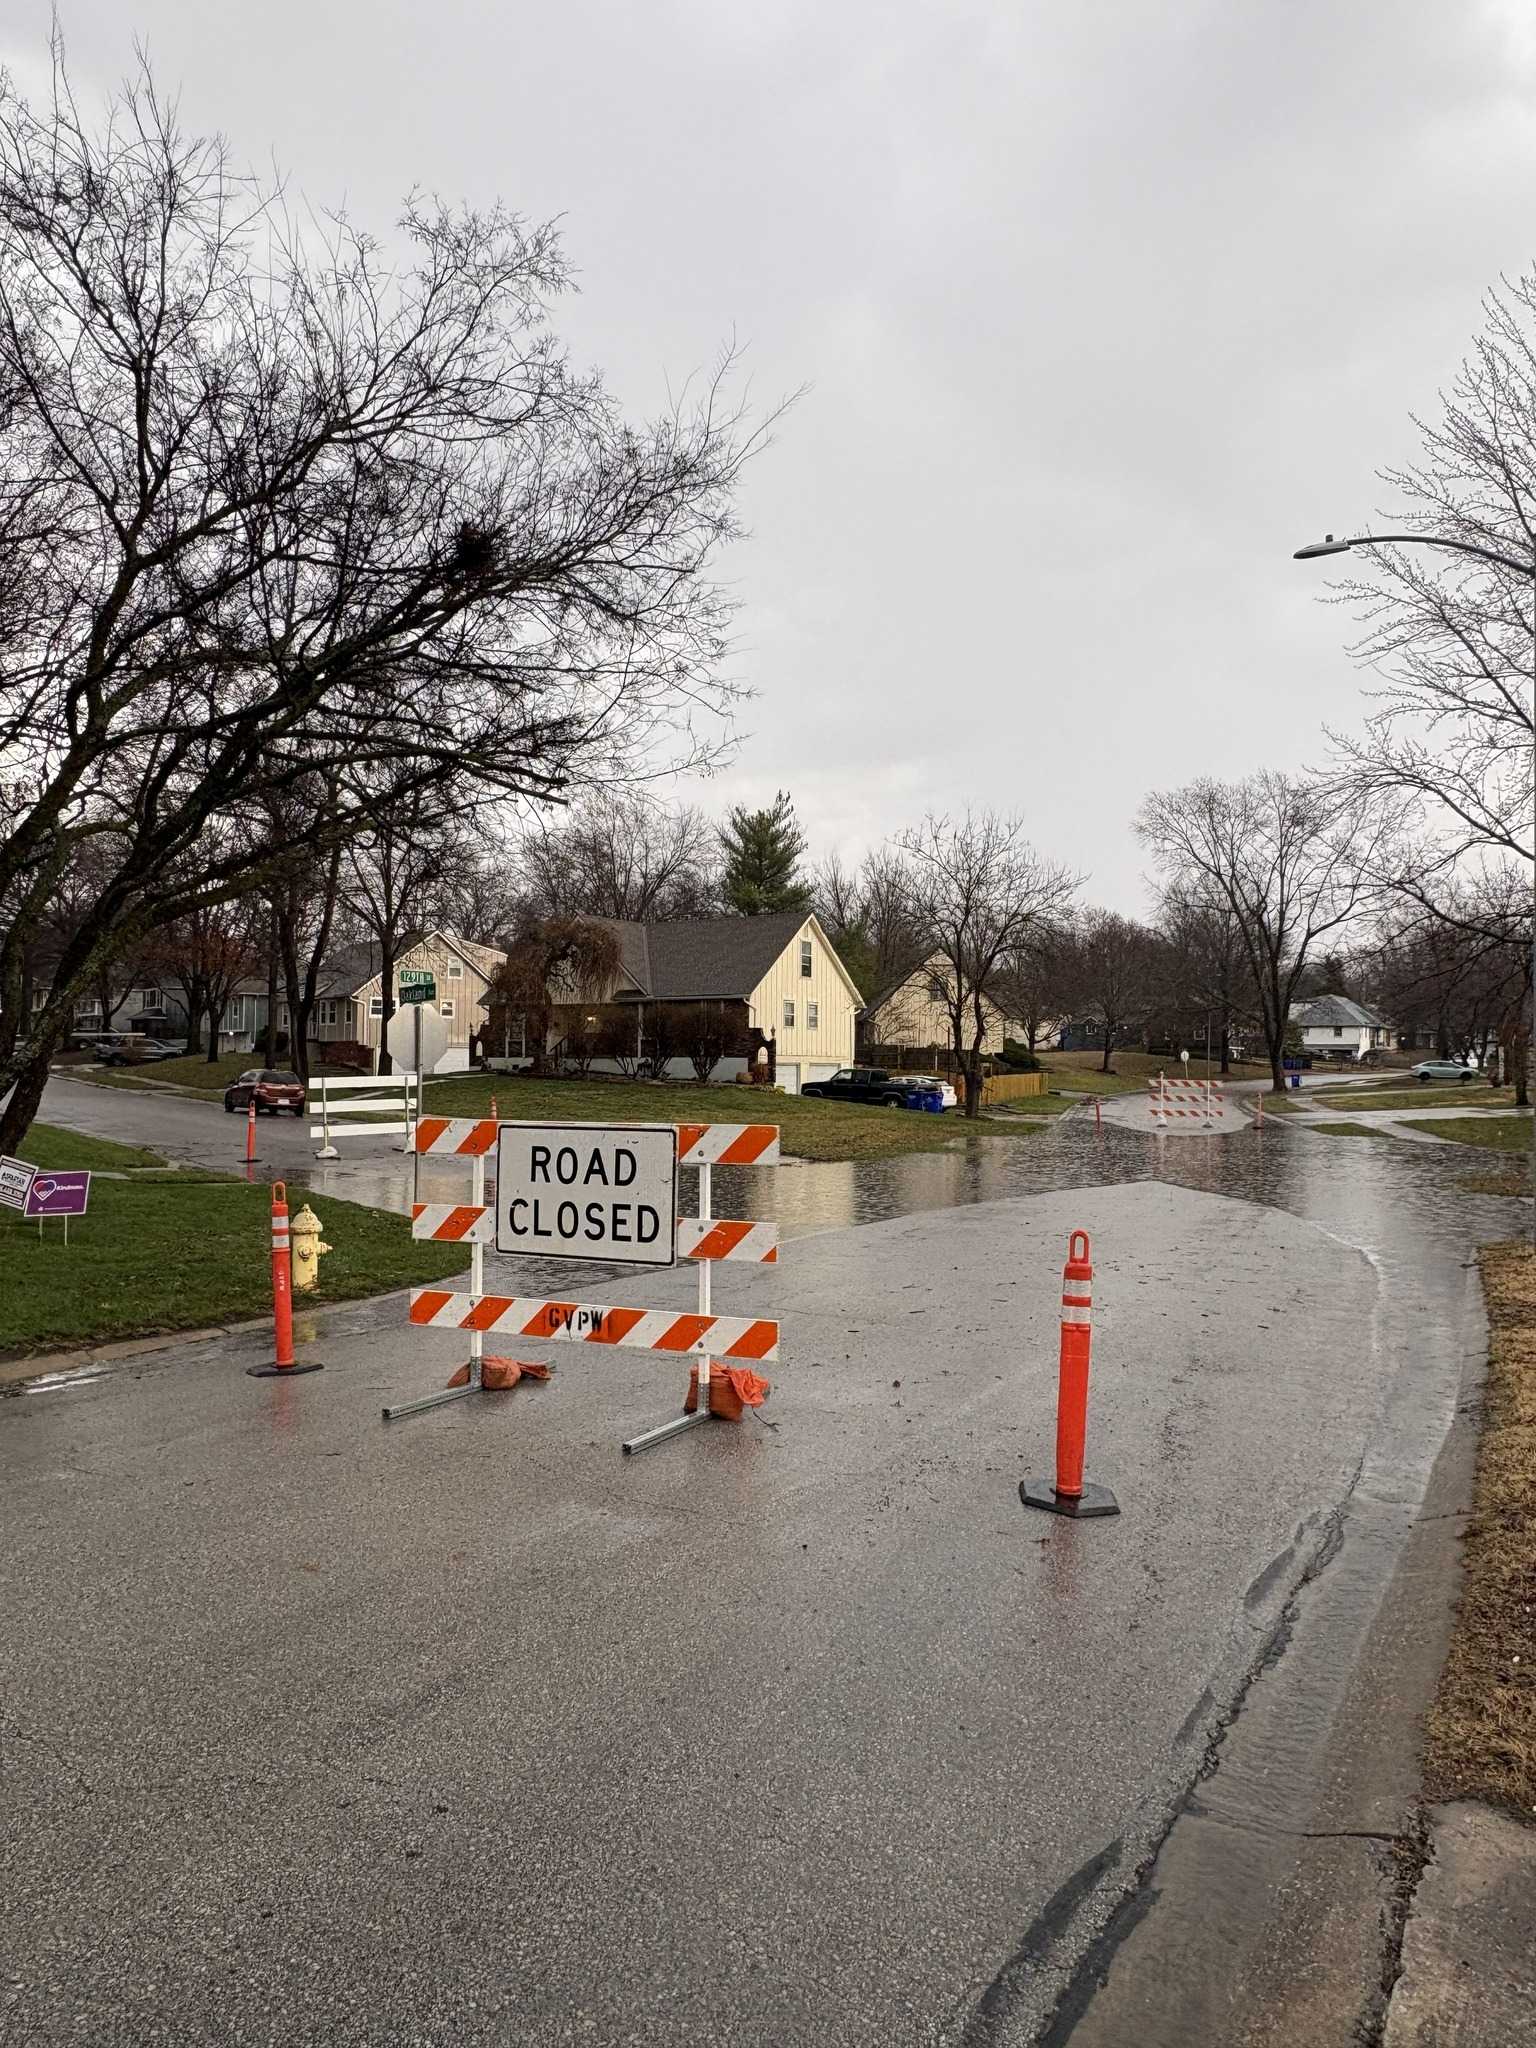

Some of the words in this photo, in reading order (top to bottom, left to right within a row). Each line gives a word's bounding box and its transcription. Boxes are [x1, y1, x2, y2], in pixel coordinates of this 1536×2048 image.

[403, 971, 425, 984] 129TH
[530, 1145, 637, 1187] ROAD
[509, 1198, 660, 1243] CLOSED
[549, 1307, 604, 1333] GVPW
